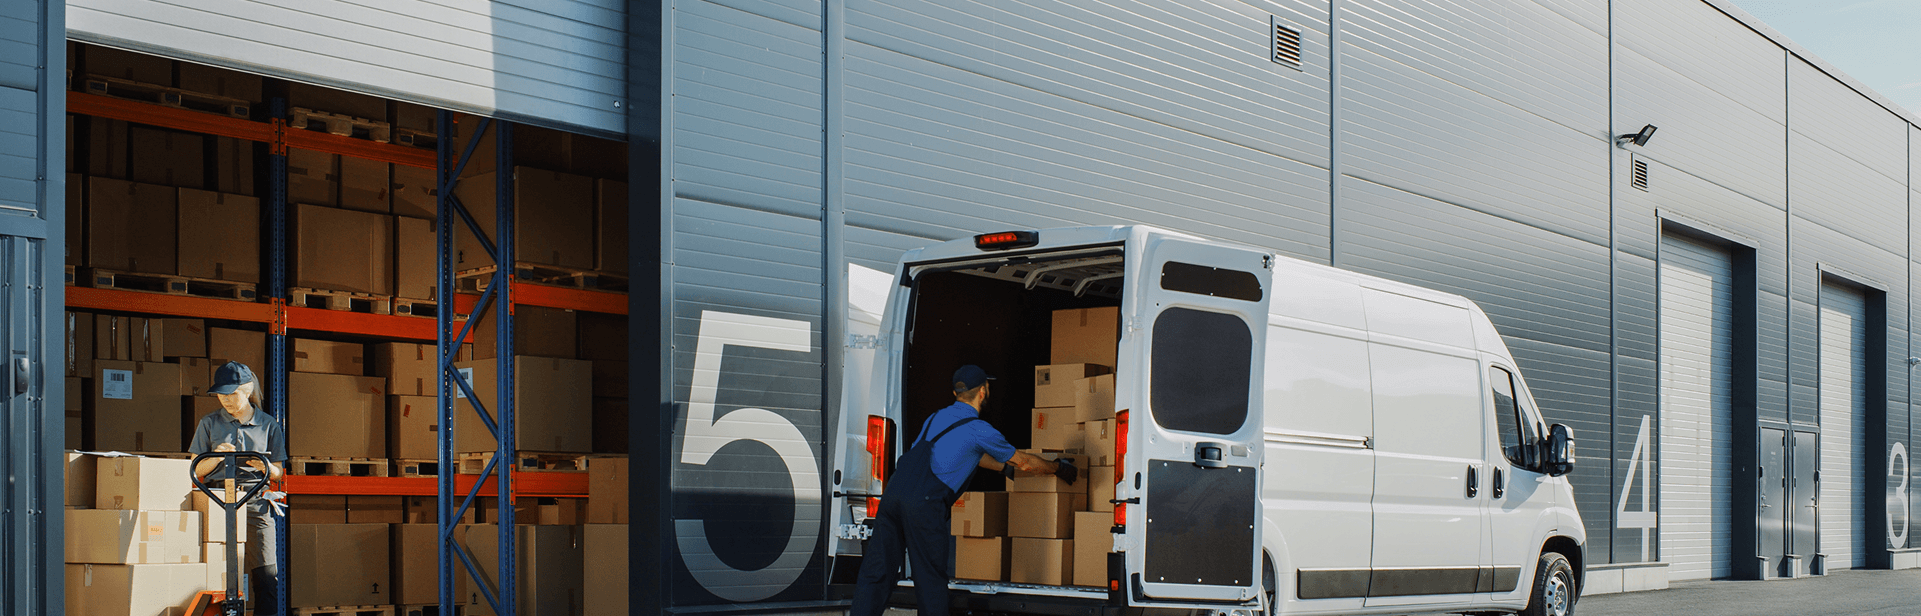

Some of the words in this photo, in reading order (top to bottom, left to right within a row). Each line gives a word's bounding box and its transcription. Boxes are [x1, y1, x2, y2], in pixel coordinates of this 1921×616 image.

[674, 309, 822, 601] 5
[1616, 414, 1657, 562] 4
[1888, 441, 1909, 549] 3
